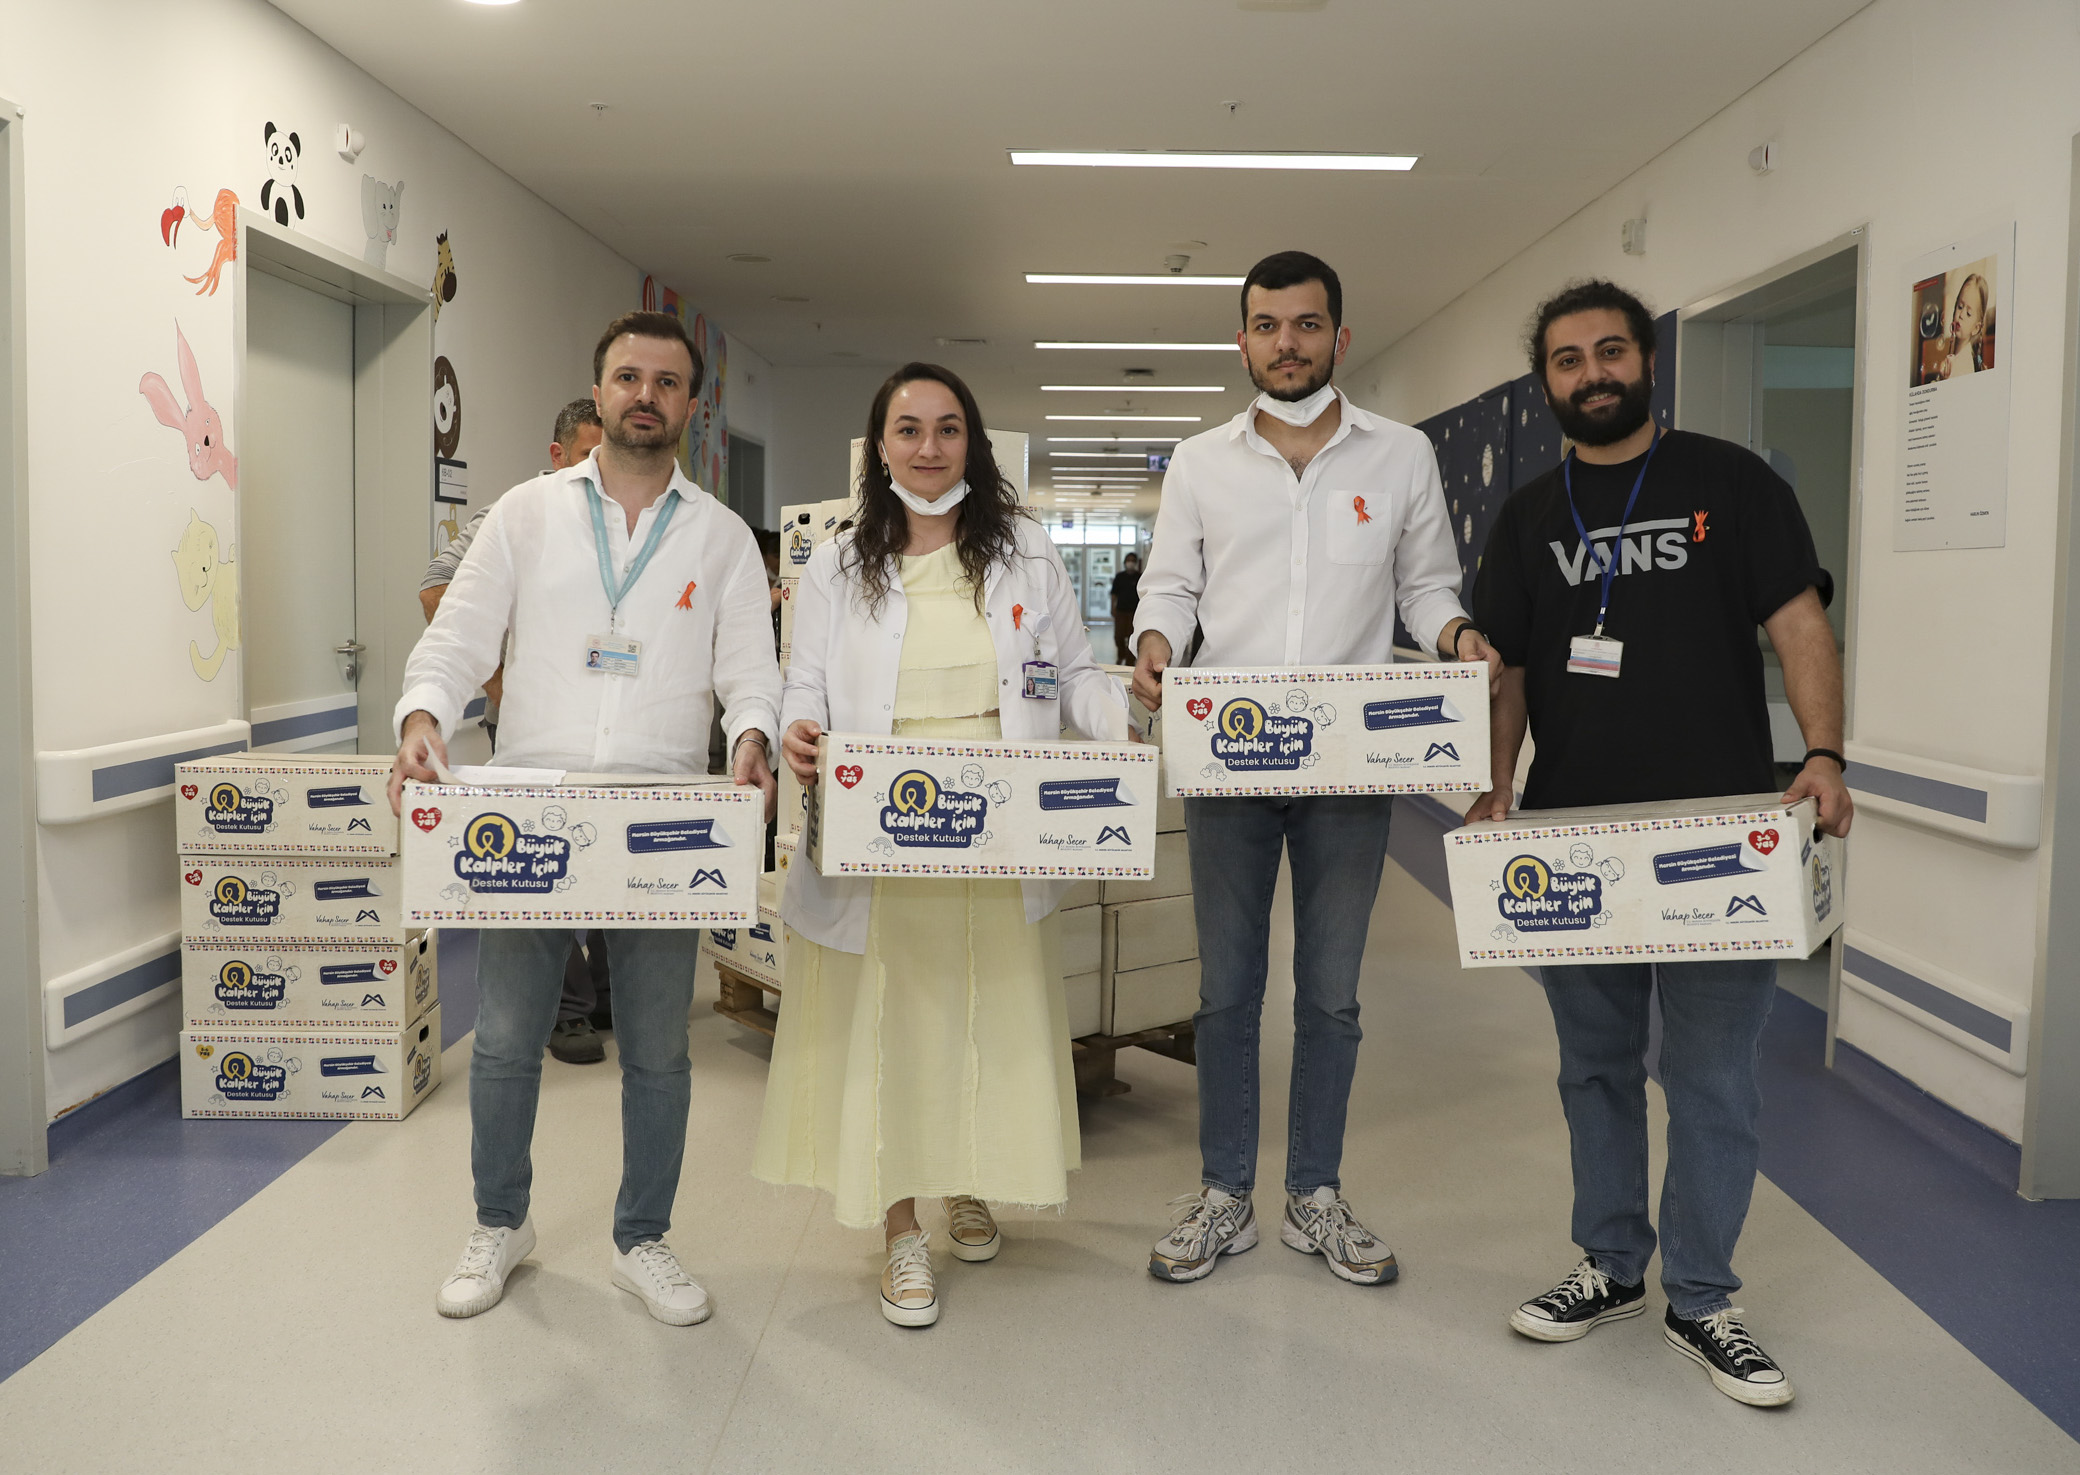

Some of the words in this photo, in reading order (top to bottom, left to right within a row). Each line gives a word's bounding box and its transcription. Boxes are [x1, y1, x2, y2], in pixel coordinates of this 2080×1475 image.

[1549, 518, 1689, 586] VANS
[1264, 720, 1308, 738] Büyük
[1216, 738, 1274, 755] Kalpler
[1279, 738, 1304, 756] için
[1228, 758, 1260, 766] Destek
[1262, 757, 1295, 765] Kutusu
[1366, 752, 1392, 768] Vahap
[240, 798, 270, 811] Büyük
[937, 794, 982, 814] Büyük
[208, 810, 247, 822] Kalpler
[251, 811, 267, 824] için
[885, 811, 946, 831] Kalpler
[951, 814, 976, 833] için
[896, 834, 930, 842] Destek
[933, 834, 967, 843] Kutusu
[1039, 832, 1065, 850] Vahap
[1756, 834, 1770, 842] 3-6
[516, 838, 565, 857] Büyük
[460, 857, 525, 876] Kalpler
[531, 858, 560, 878] için
[472, 878, 508, 887] Destek
[512, 879, 549, 888] Kutusu
[627, 876, 655, 894] Vahap
[1550, 876, 1596, 895] Büyük
[246, 891, 276, 904] Büyük
[1503, 896, 1562, 915] Kalpler
[1568, 895, 1593, 915] için
[213, 903, 253, 915] Kalpler
[257, 904, 274, 916] için
[1661, 908, 1690, 925] Vahap
[1517, 918, 1549, 927] Destek
[1552, 917, 1586, 925] Kutusu
[252, 975, 282, 988] Büyük
[218, 987, 259, 999] Kalpler
[262, 988, 279, 1000] için
[252, 1066, 283, 1080] Büyük
[218, 1078, 259, 1090] Kalpler
[262, 1079, 280, 1091] için
